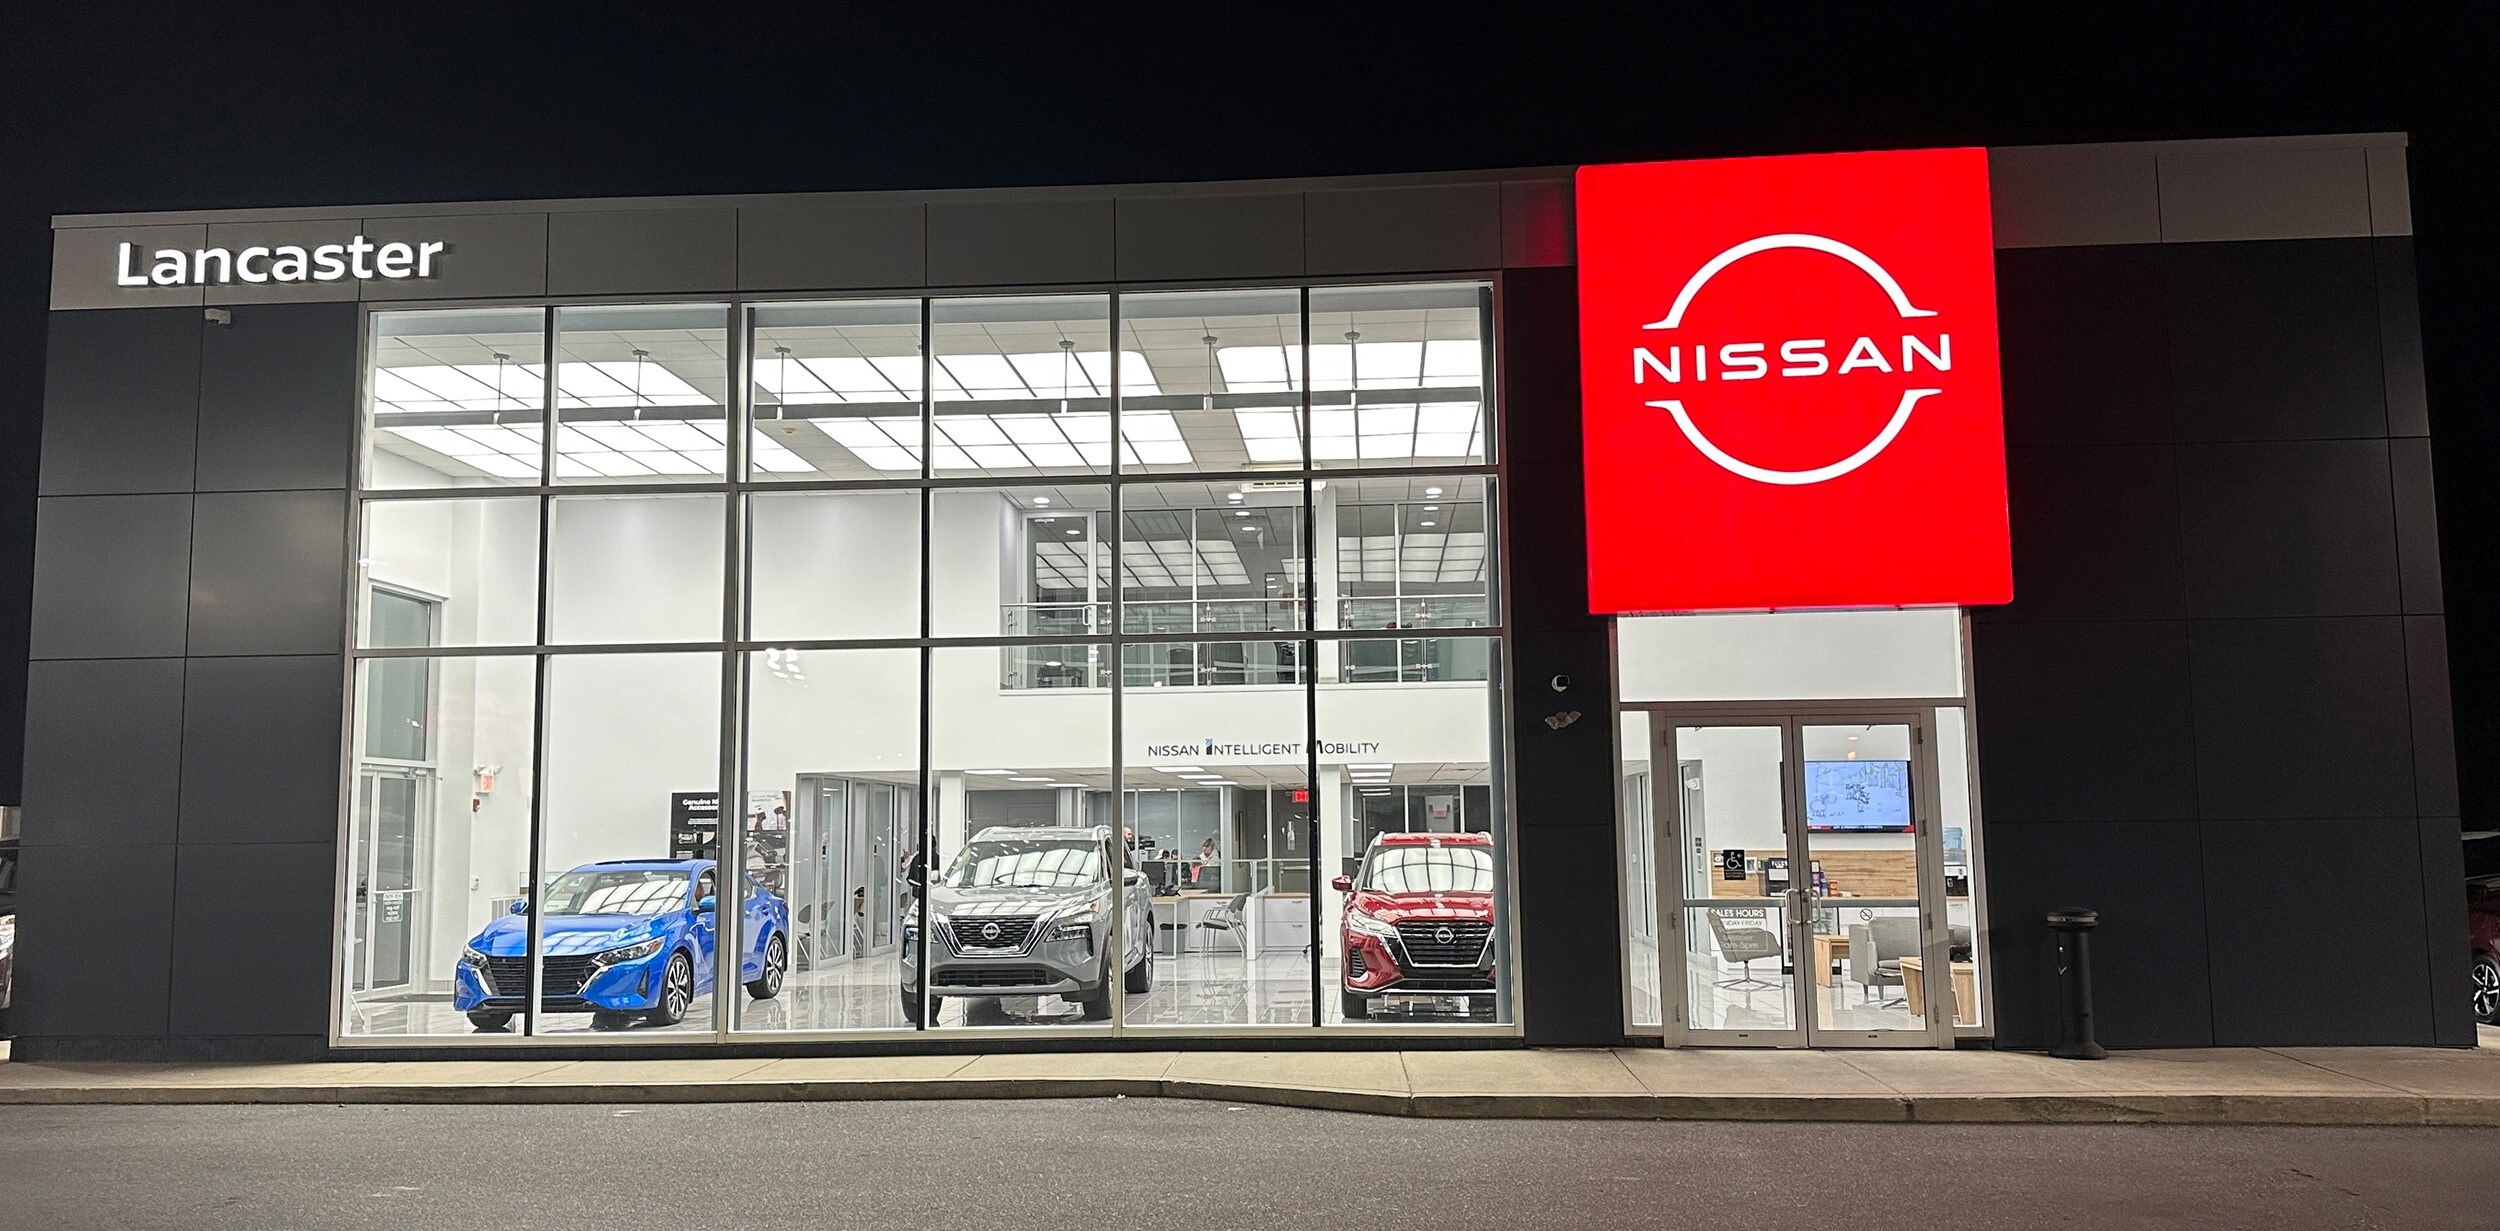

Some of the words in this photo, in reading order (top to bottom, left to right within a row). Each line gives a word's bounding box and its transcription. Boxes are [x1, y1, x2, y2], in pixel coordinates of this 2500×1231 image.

[117, 235, 444, 287] Lancaster
[1633, 334, 1951, 384] NISSAN
[1148, 745, 1199, 756] NISSAN
[1736, 909, 1764, 918] HOURS
